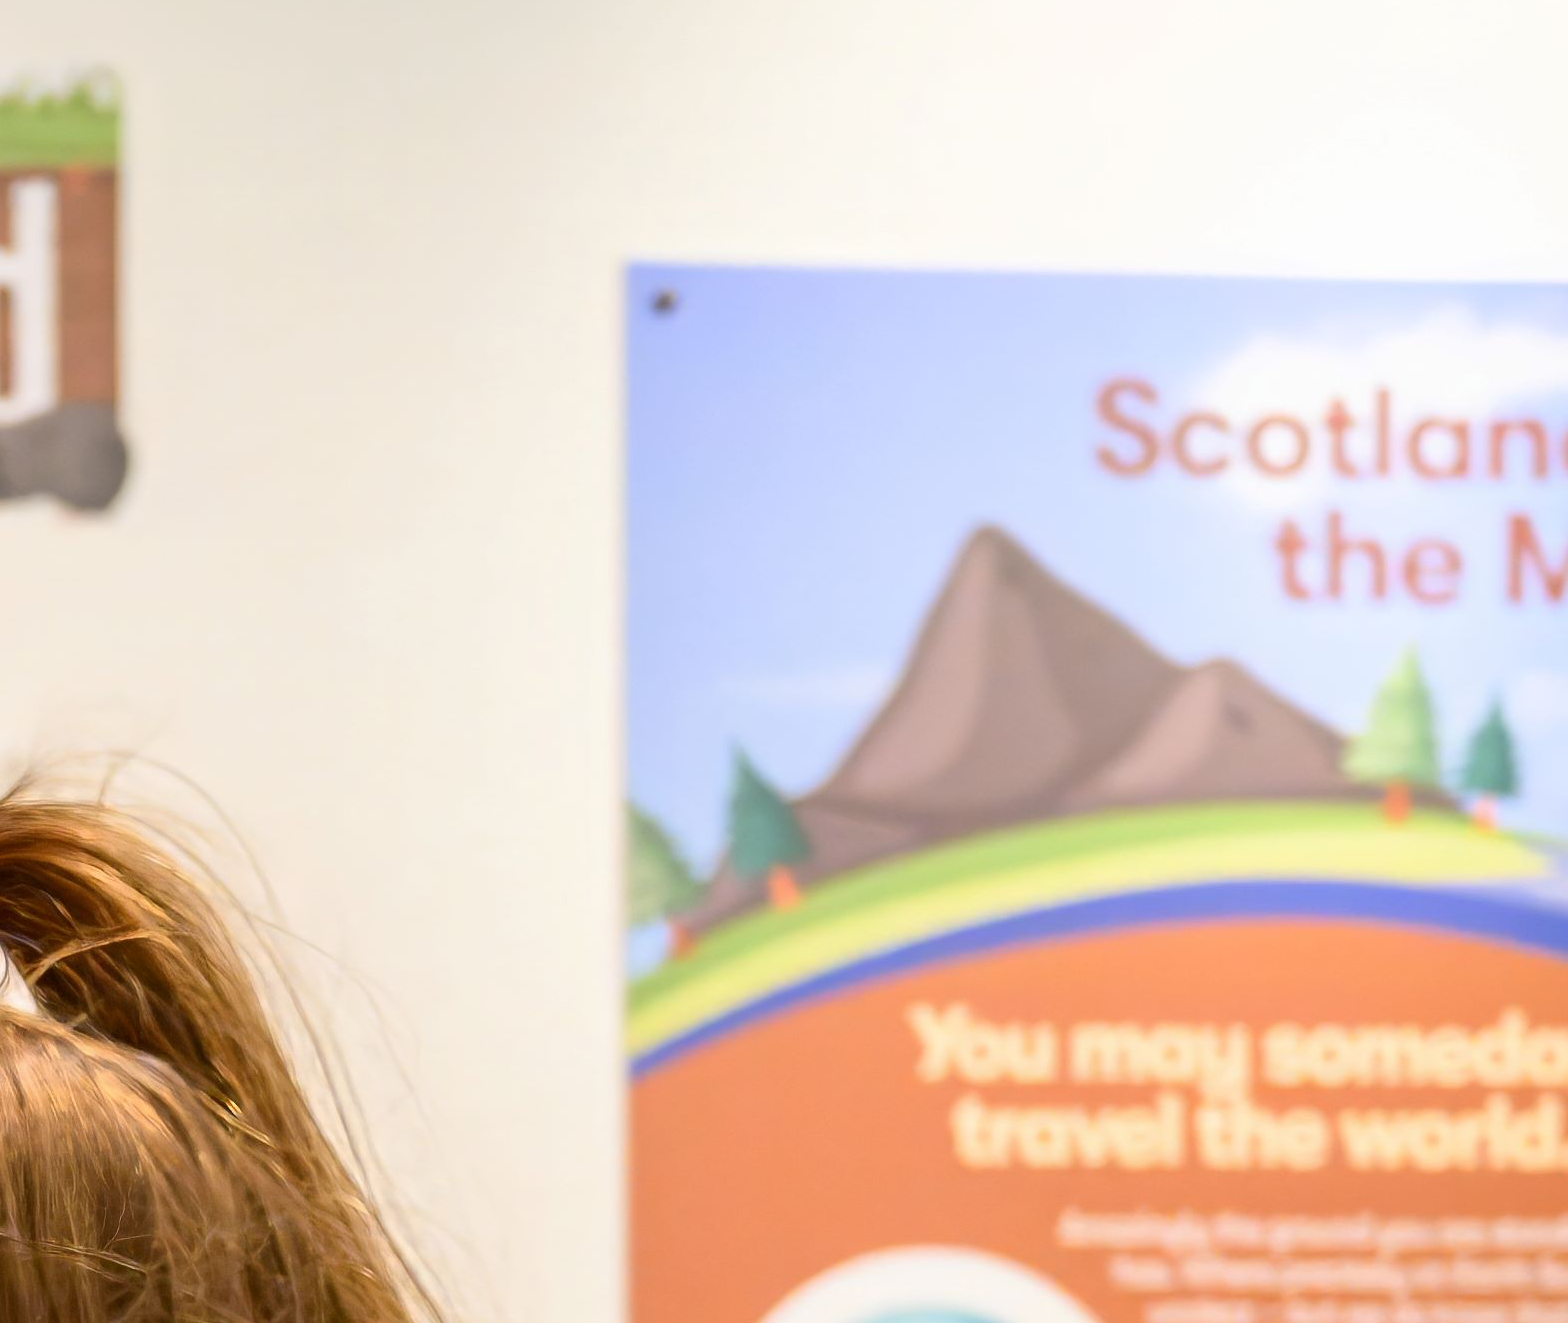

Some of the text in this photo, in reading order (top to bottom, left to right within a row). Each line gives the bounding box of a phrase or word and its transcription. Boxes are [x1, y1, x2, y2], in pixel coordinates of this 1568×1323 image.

[1094, 375, 1568, 482] Scotlan
[1274, 509, 1466, 607] the
[905, 1000, 1568, 1108] You may someda
[951, 1092, 1185, 1171] travel
[1195, 1096, 1329, 1173] the
